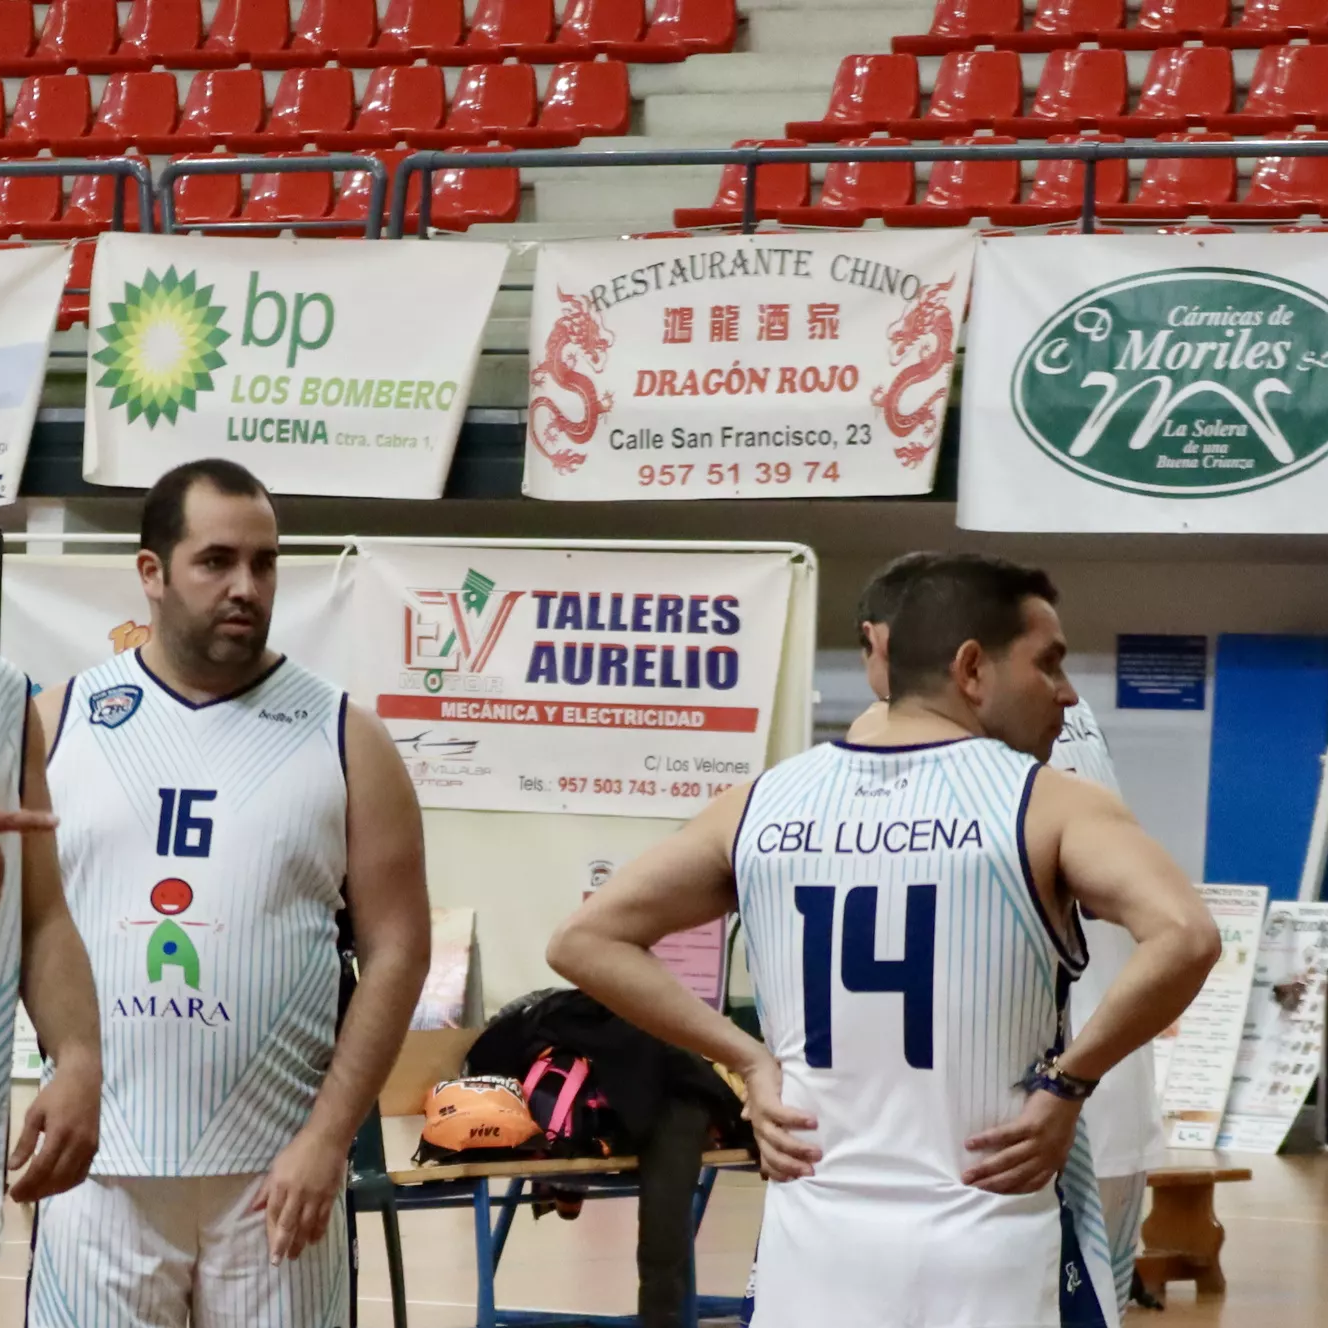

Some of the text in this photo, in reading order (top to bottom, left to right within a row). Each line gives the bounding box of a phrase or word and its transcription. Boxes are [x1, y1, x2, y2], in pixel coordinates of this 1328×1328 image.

[589, 248, 922, 313] RESTAURANTE CHINO
[241, 271, 335, 368] bp
[1167, 304, 1294, 327] Cárnicas de
[1114, 328, 1292, 371] Moriles
[231, 375, 289, 406] LOS
[633, 360, 860, 397] DRAGÓN ROJO
[227, 417, 329, 445] LUCENA
[335, 433, 371, 448] Ctra.
[375, 433, 419, 449] Cabra
[609, 424, 872, 450] Calle San Francisco, 23
[1162, 419, 1249, 437] La Solera
[1156, 454, 1256, 470] Buena Crianza
[1182, 440, 1199, 454] de
[637, 461, 840, 486] 957 51 39 74
[532, 589, 741, 636] TALLERES
[525, 640, 740, 691] AURELIO
[441, 701, 705, 729] MECÁNICA Y ELECTRICIDAD
[644, 754, 751, 775] C/ Los Velones
[558, 775, 587, 793] 957
[593, 777, 623, 794] 503
[629, 778, 656, 795] 743
[670, 780, 701, 797] 620
[156, 787, 218, 858] 16
[757, 818, 984, 854] CBL LUCENA
[794, 883, 938, 1070] 14
[112, 995, 231, 1027] AMARA
